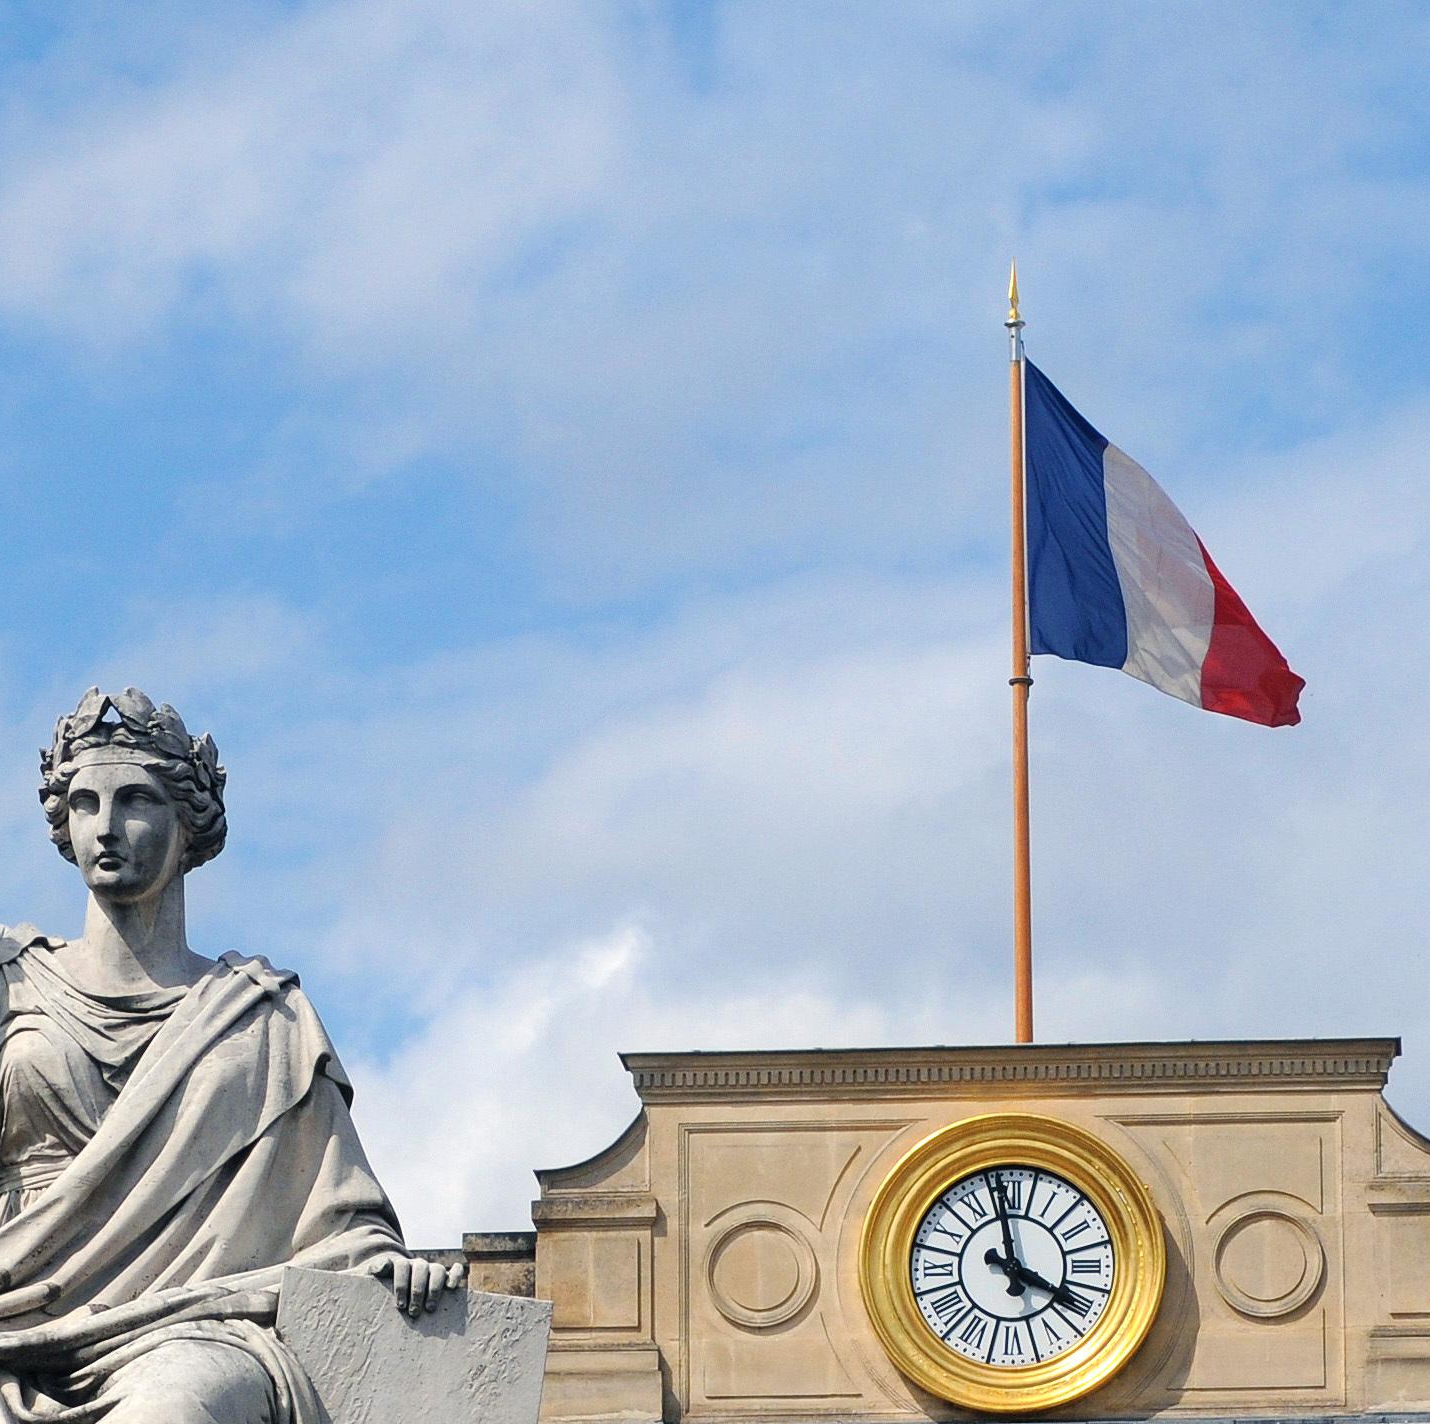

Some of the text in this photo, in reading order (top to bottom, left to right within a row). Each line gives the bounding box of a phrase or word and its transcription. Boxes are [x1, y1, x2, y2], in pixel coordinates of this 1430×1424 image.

[958, 1190, 989, 1222] XI
[1039, 1190, 1058, 1218] I
[933, 1221, 963, 1245] X
[1060, 1218, 1091, 1242] II
[923, 1259, 953, 1278] IX
[1071, 1259, 1102, 1275] III
[930, 1288, 967, 1327] VIII
[958, 1314, 988, 1350] VII
[1002, 1325, 1023, 1356] VI
[1041, 1317, 1062, 1345] V
